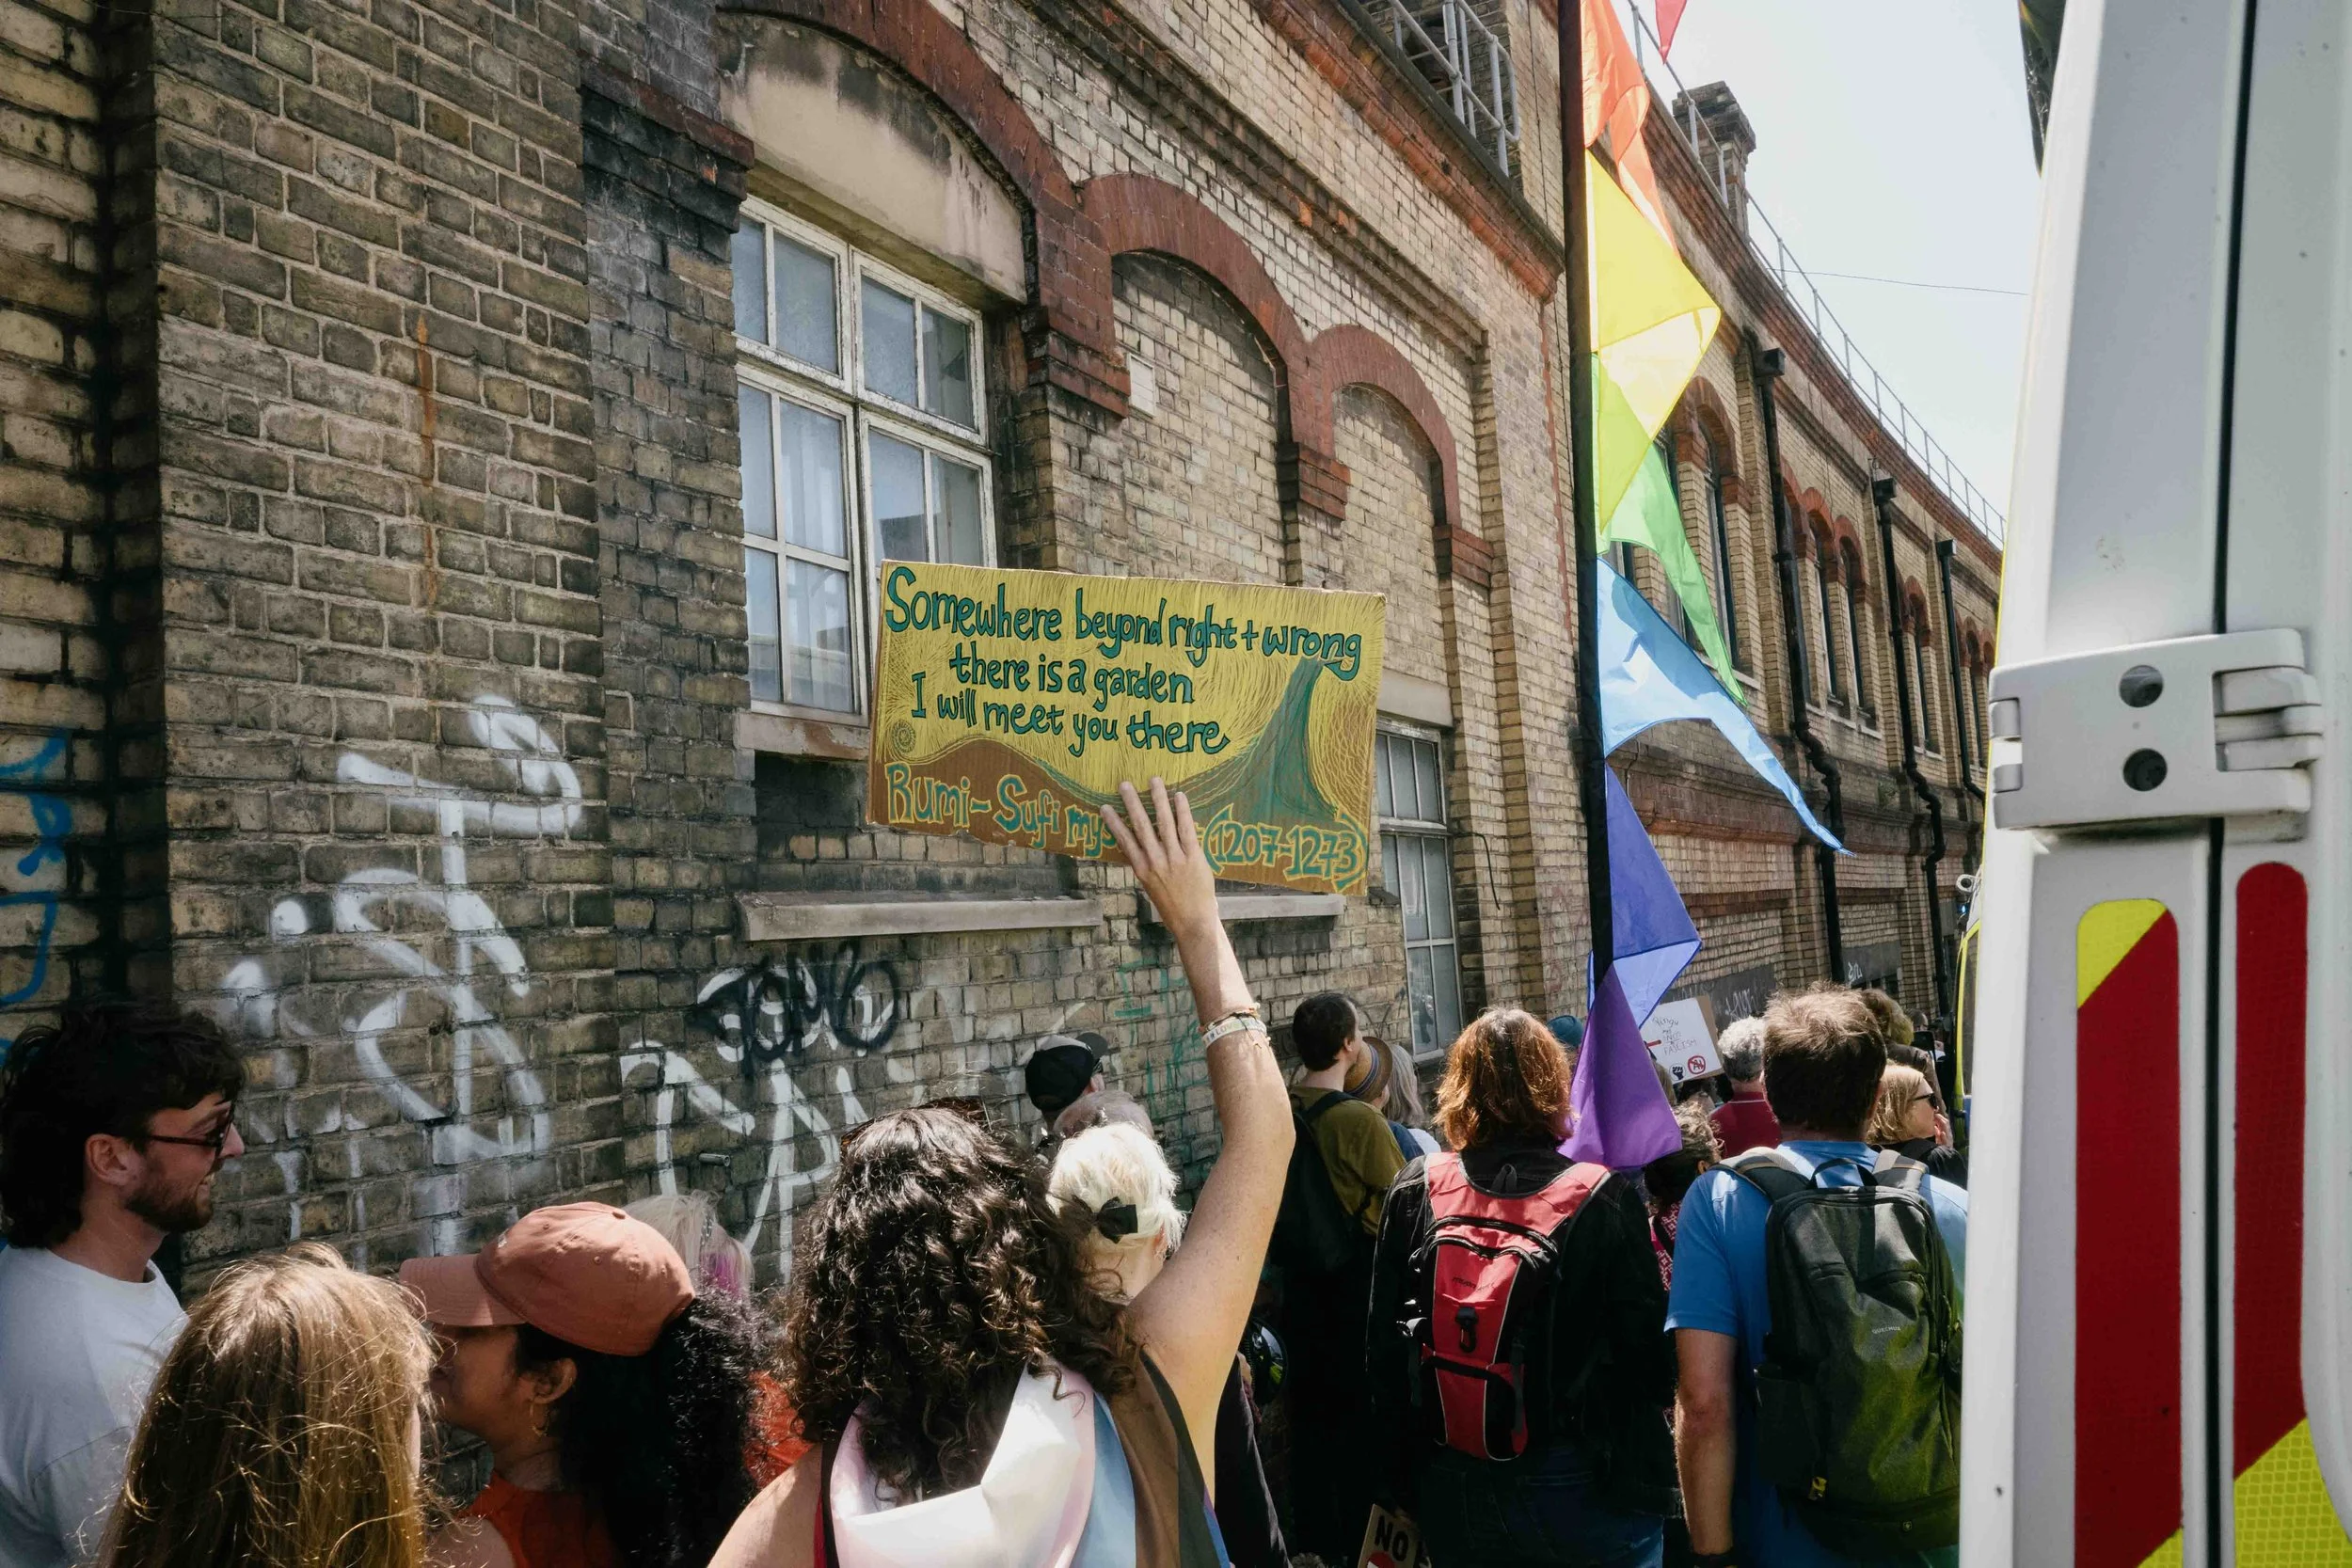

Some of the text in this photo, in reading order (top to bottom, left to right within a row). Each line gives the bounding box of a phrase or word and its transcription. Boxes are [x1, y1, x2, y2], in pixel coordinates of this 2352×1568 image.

[885, 566, 1062, 641] Somewhere
[1075, 588, 1167, 658] beyond
[1168, 604, 1237, 668] right
[1262, 626, 1361, 681] wrong
[949, 641, 1195, 712] there is a garden
[911, 672, 1231, 757] I will meet you there
[993, 774, 1061, 849] Sufi
[1375, 1515, 1408, 1562] NO
